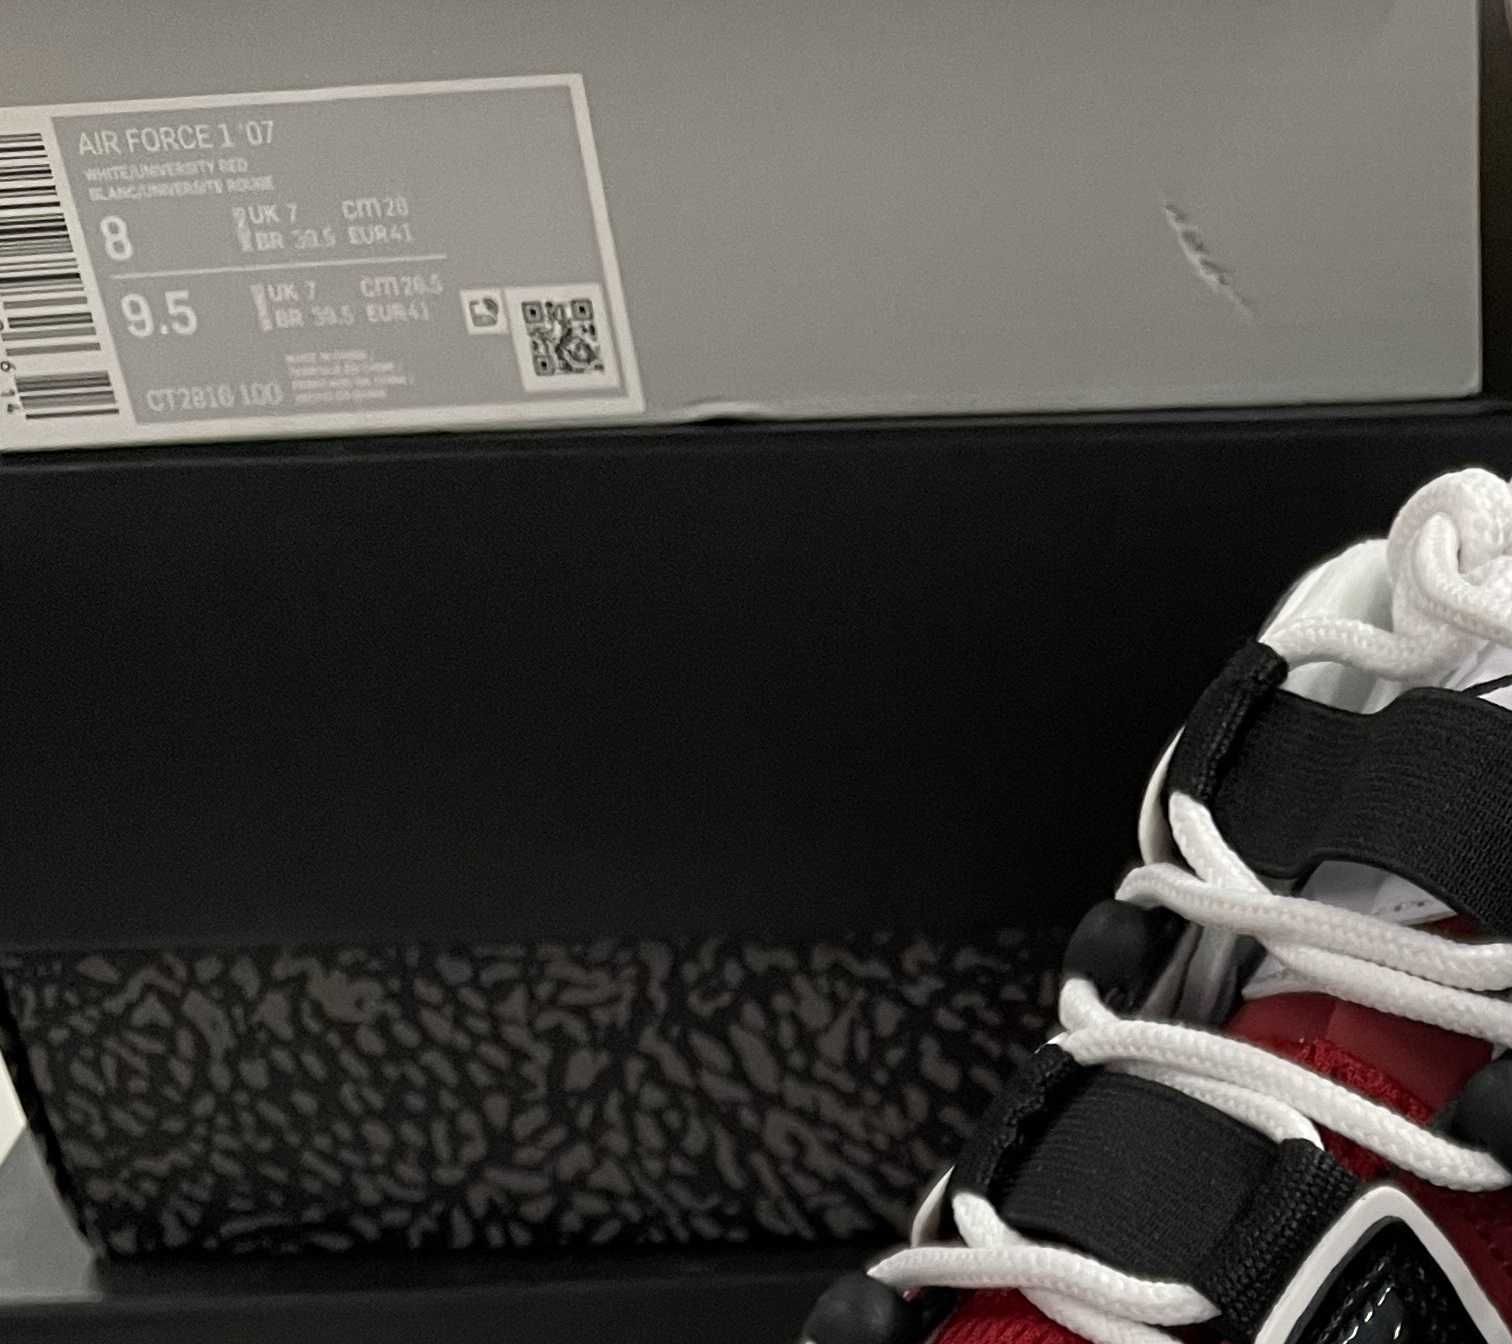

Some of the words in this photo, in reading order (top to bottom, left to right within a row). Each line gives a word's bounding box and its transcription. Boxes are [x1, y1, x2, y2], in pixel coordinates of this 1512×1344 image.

[79, 130, 121, 156] AIR
[126, 124, 214, 152] FORCE
[217, 123, 235, 147] 1
[238, 120, 274, 146] '07
[248, 204, 280, 224] UK
[100, 215, 133, 260] 8
[120, 290, 198, 337] 9.5
